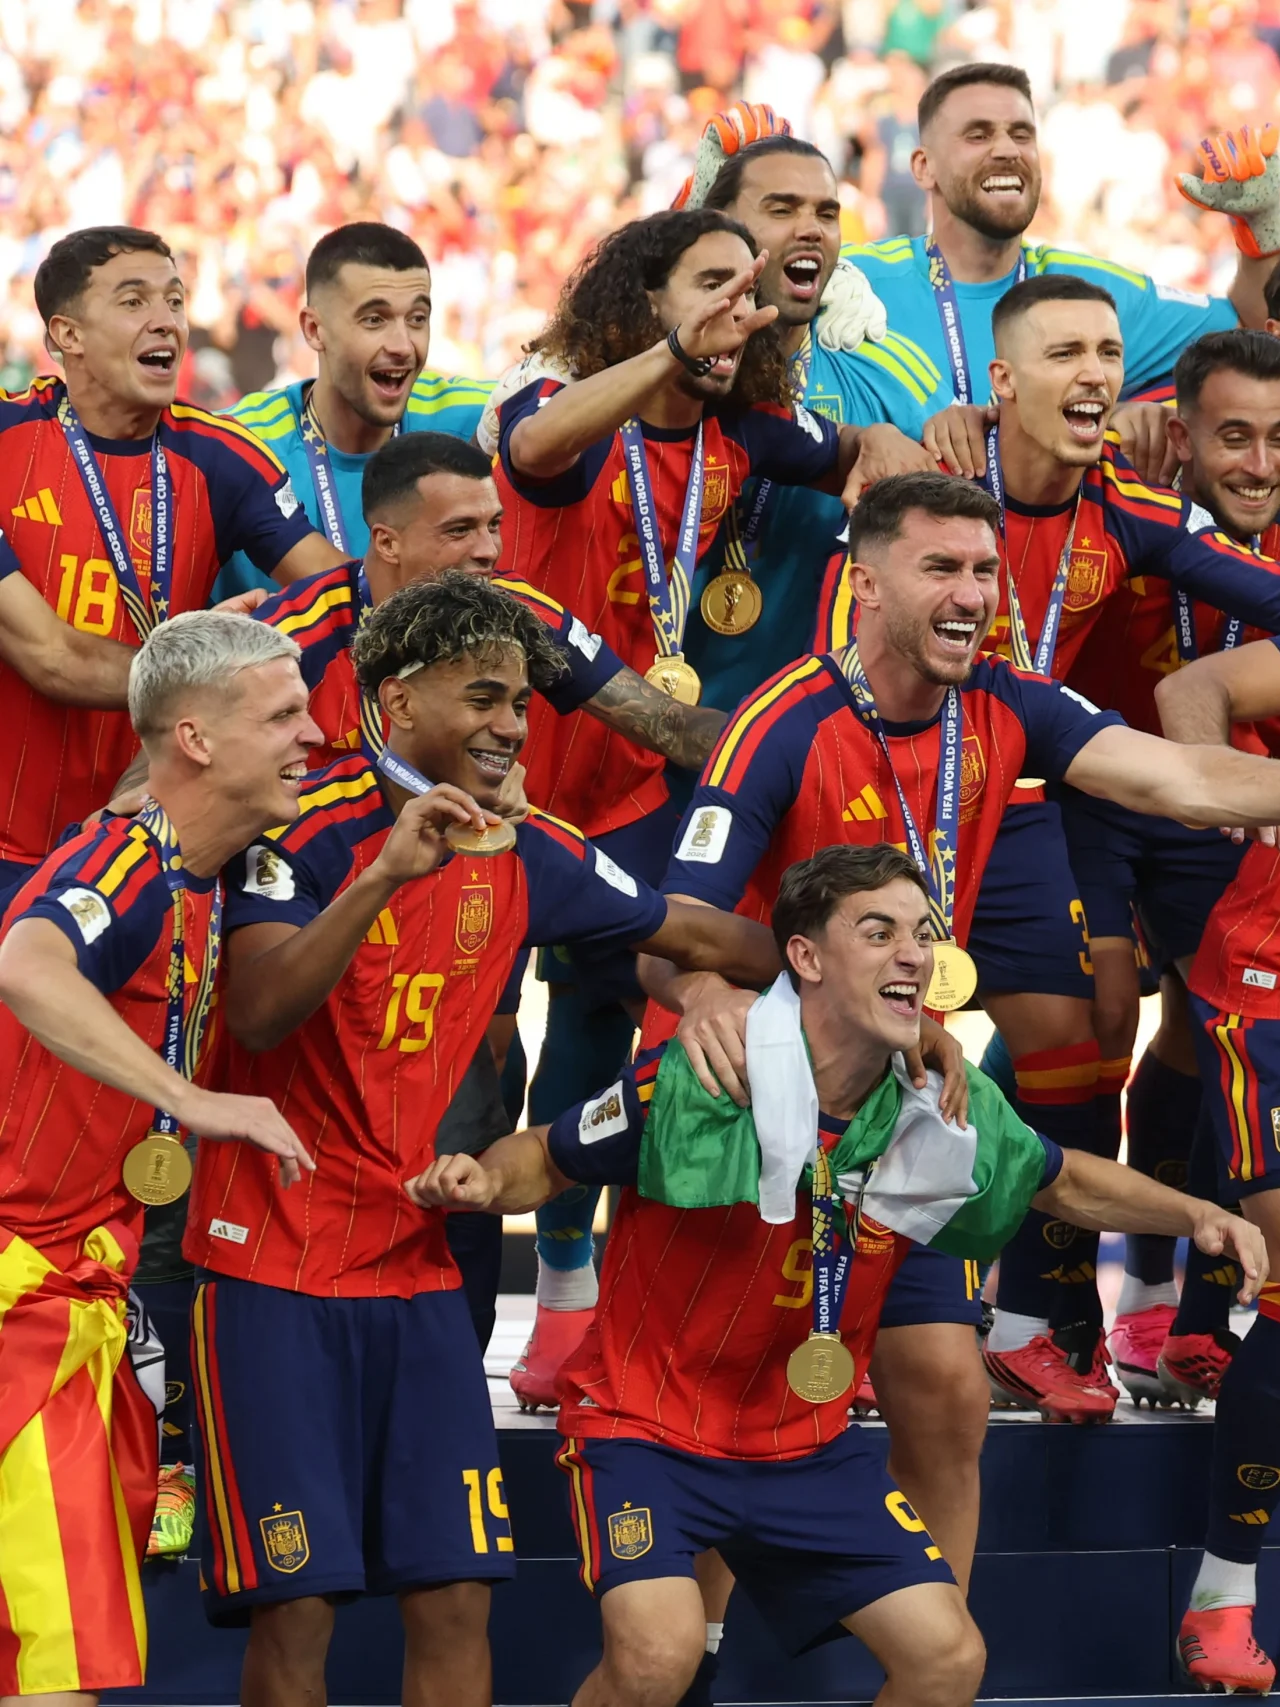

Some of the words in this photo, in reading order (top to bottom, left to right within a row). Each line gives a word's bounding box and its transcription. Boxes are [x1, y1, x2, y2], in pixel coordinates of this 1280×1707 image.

[942, 301, 956, 327] FIFA
[948, 325, 963, 368] WORLD
[956, 368, 968, 393] CUP
[73, 438, 91, 464] FIFA
[629, 444, 642, 471] FIFA
[986, 435, 997, 460] CUP
[83, 463, 106, 506] WORLD
[156, 474, 167, 499] CUP
[315, 464, 329, 490] FIFA
[693, 460, 702, 485] CUP
[989, 459, 1004, 503] WORLD
[633, 470, 649, 516] WORLD
[686, 486, 699, 526] WORLD
[99, 504, 114, 531] CUP
[321, 489, 339, 531] WORLD
[156, 505, 167, 546] WORLD
[640, 515, 654, 541] CUP
[682, 526, 695, 553] FIFA
[744, 515, 759, 541] FIFA
[106, 530, 128, 573] 2026
[156, 546, 166, 572] FIFA
[645, 541, 661, 585] 2026
[56, 553, 119, 637] 18
[1042, 603, 1057, 645] 2026
[1179, 605, 1192, 648] 2026
[1037, 643, 1049, 667] CUP
[946, 719, 957, 747] CUP
[943, 746, 956, 793] WORLD
[942, 792, 953, 820] FIFA
[901, 803, 913, 830] CUP
[908, 829, 926, 873] 2026
[376, 973, 445, 1053] 19
[168, 1015, 180, 1044] FIFA
[818, 1267, 829, 1294] FIFA
[834, 1255, 848, 1286] FIFA
